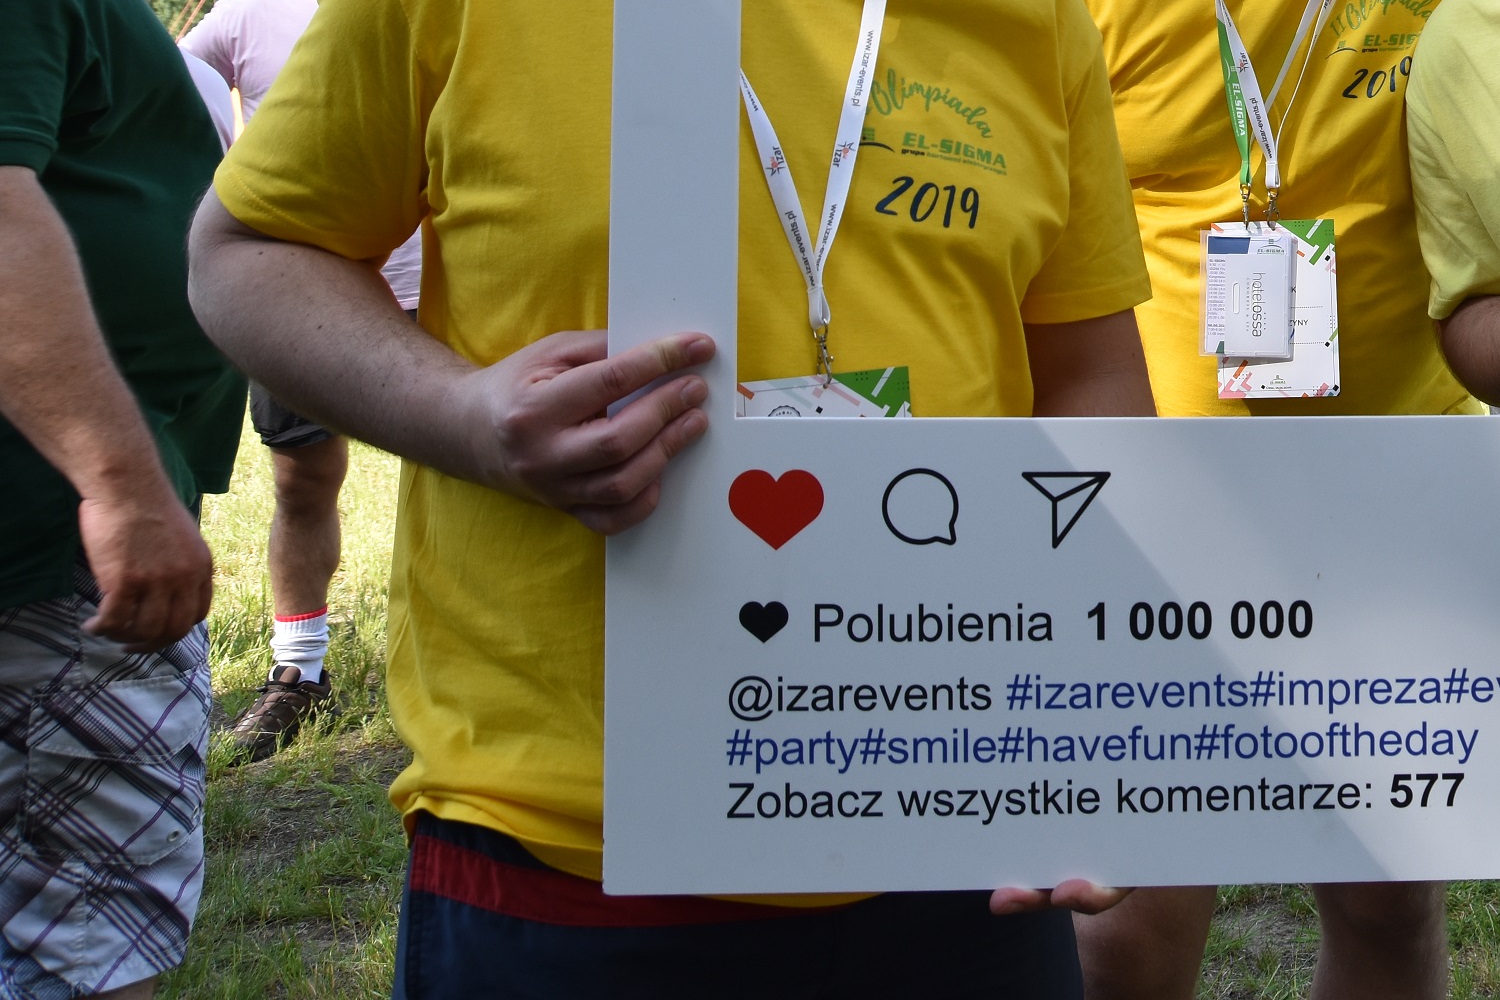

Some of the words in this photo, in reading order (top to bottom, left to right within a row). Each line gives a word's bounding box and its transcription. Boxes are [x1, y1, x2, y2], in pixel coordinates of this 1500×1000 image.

[1363, 32, 1419, 47] EL-SIG
[851, 29, 874, 107] www.izar-events.pl
[872, 68, 993, 139] Olimpiada
[1232, 82, 1246, 138] EL-SIGMA
[1250, 97, 1273, 159] www.izar-events.pl
[902, 131, 1007, 169] EL-SIGMA
[874, 176, 980, 229] 2019
[814, 602, 1053, 643] Polubienia
[1087, 601, 1106, 641] 1
[1129, 600, 1213, 641] 000
[1230, 600, 1313, 640] 000
[728, 675, 993, 722] @izarevents
[726, 721, 1480, 774] #party#smile#havefun#fotooftheday
[726, 782, 884, 819] Zobacz
[897, 779, 1101, 826] wszystkie
[1117, 777, 1373, 815] komentarze:
[1389, 772, 1466, 809] 577
